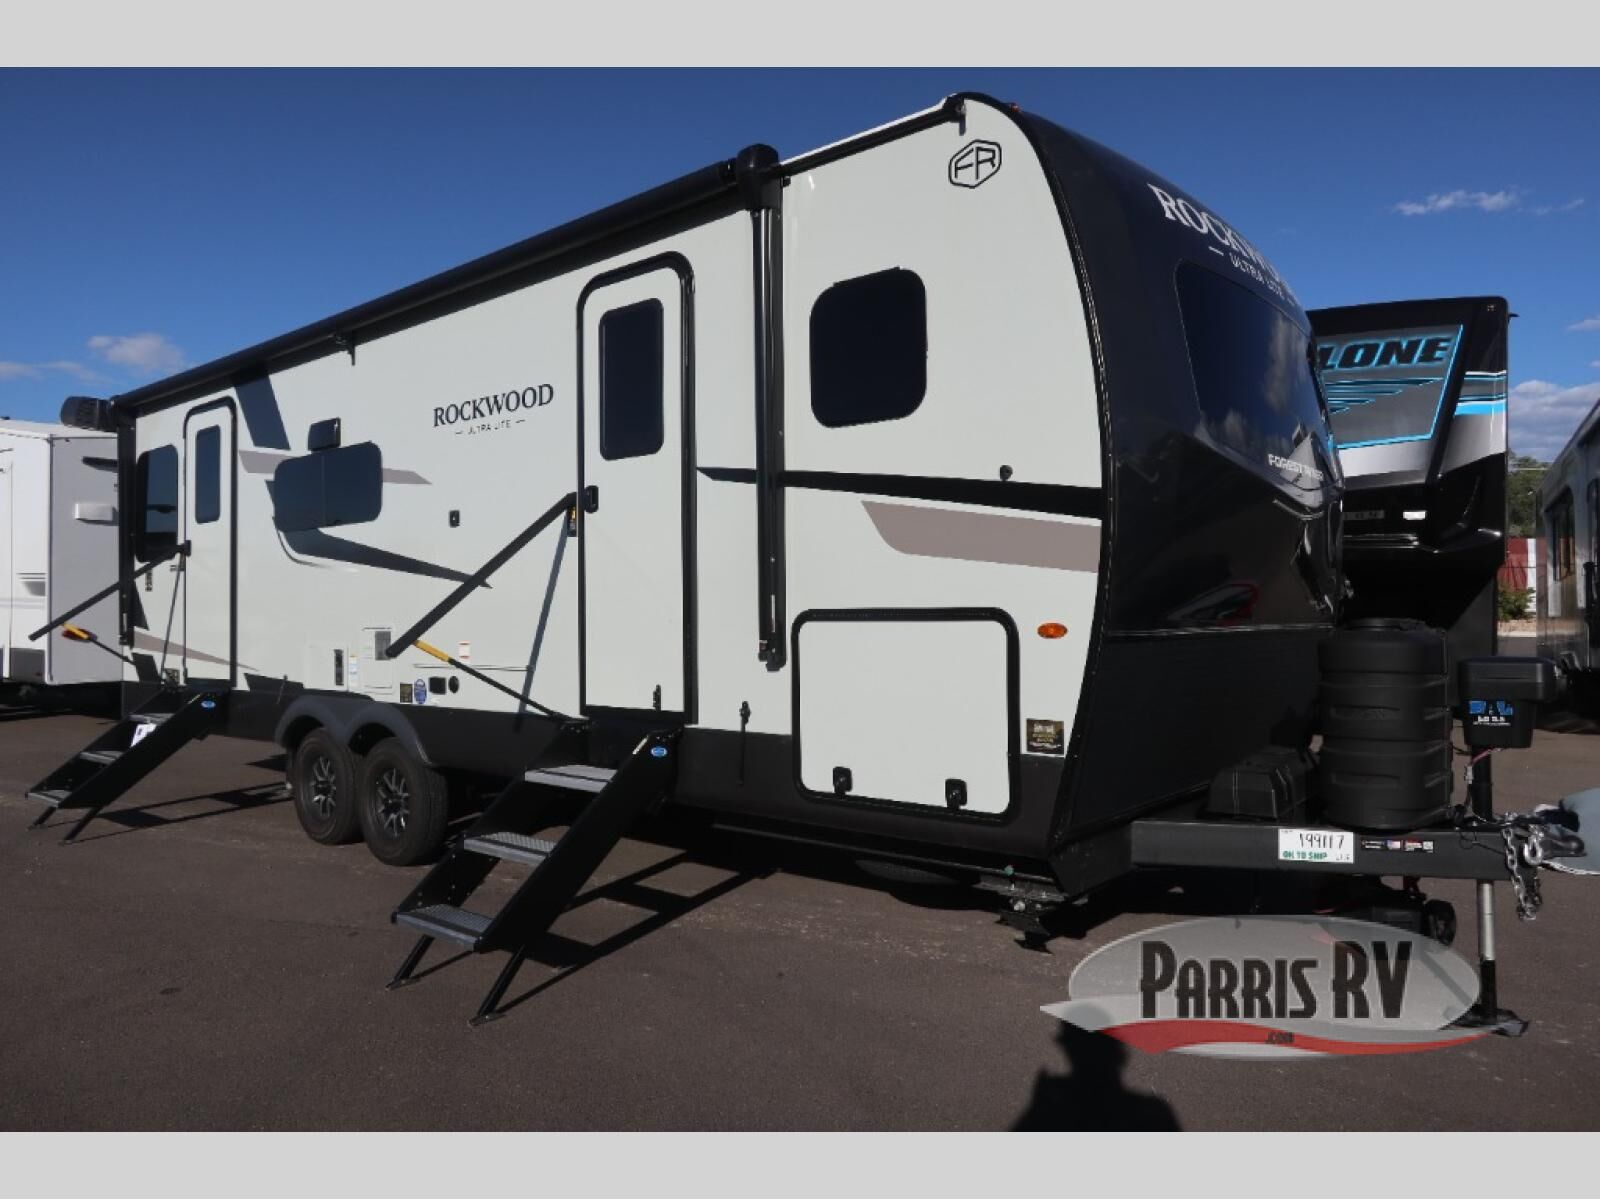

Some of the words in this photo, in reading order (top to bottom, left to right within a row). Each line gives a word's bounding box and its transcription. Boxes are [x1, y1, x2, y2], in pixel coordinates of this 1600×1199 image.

[954, 146, 996, 180] FR
[433, 383, 554, 427] ROCKWOOD
[467, 424, 492, 435] ULTRA
[495, 420, 511, 430] LITE
